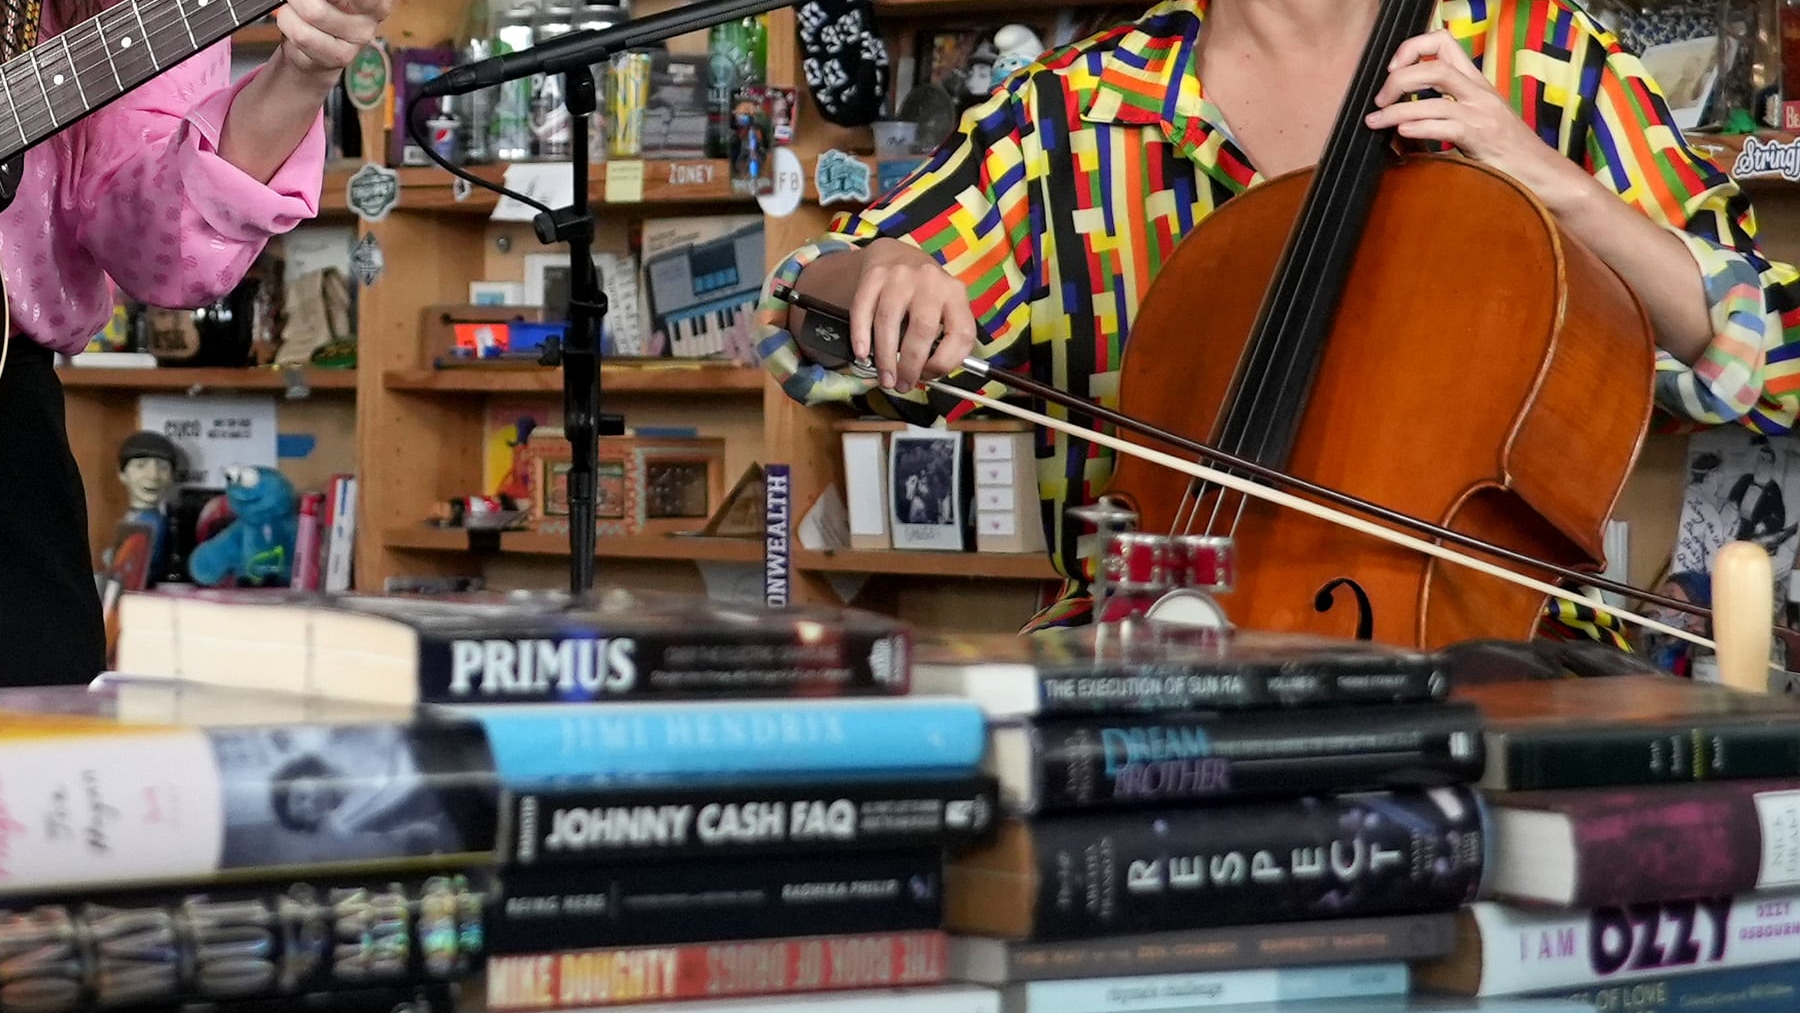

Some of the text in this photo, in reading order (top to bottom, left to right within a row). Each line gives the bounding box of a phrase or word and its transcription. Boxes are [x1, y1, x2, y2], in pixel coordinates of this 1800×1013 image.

[449, 635, 638, 693] PRIMUS
[1046, 679, 1076, 698] THE
[1078, 676, 1163, 698] EXECUTION
[1165, 675, 1183, 695] OF
[1185, 675, 1218, 694] SUN
[560, 710, 845, 753] JIMI HENDRIX
[1101, 725, 1210, 777] DREAM
[1113, 758, 1232, 799] BROTHER
[545, 804, 691, 851] JOHNNY
[697, 801, 787, 843] CASH
[790, 798, 857, 838] FAQ
[1127, 836, 1402, 890] RESPECT
[1590, 895, 1735, 976] OZZY
[1756, 901, 1792, 919] OZZY
[1537, 927, 1578, 960] AM
[559, 947, 678, 1001] DOUGHTY
